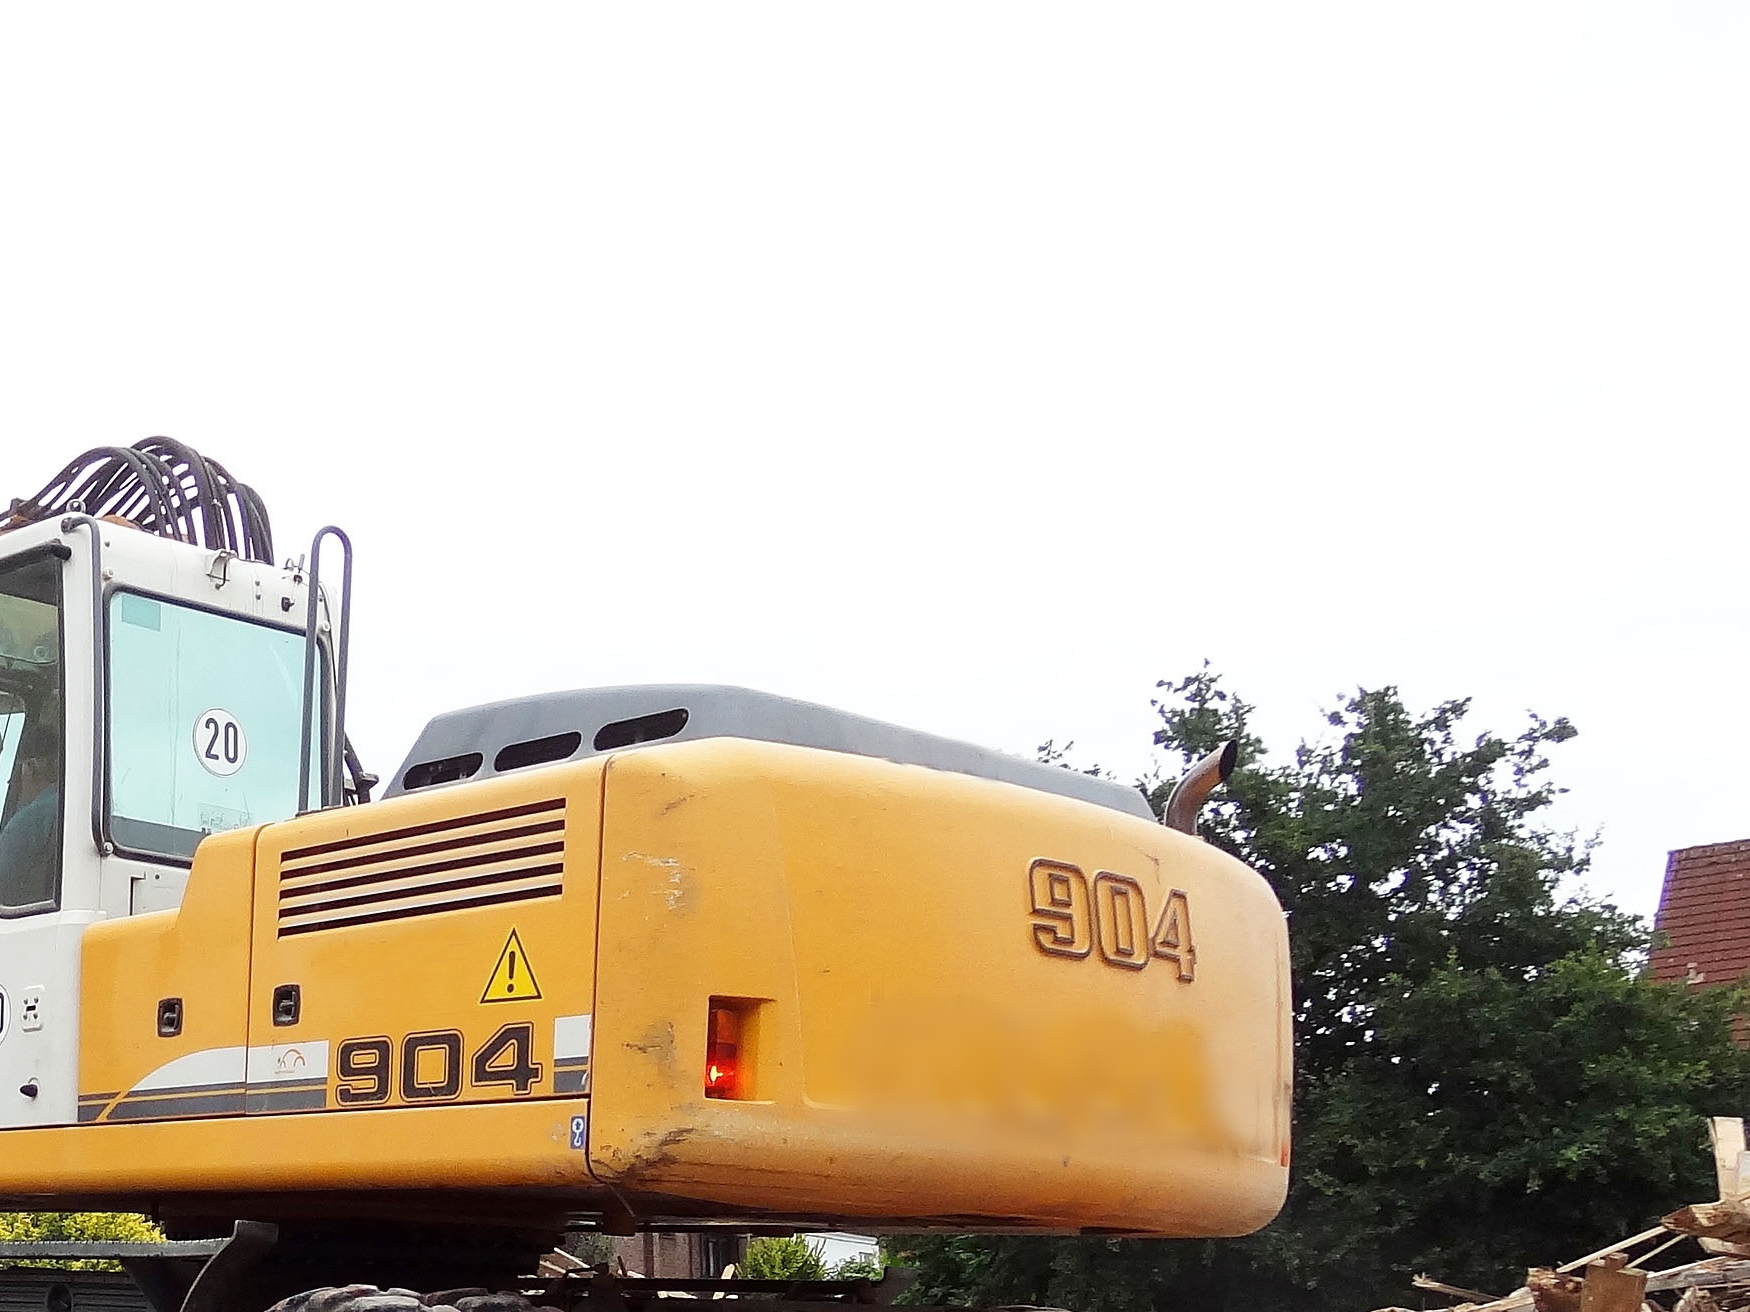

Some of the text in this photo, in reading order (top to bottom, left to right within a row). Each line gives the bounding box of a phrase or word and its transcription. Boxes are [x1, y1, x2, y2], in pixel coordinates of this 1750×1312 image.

[205, 717, 238, 764] 20
[1028, 857, 1198, 984] 904
[336, 1021, 543, 1107] 904
